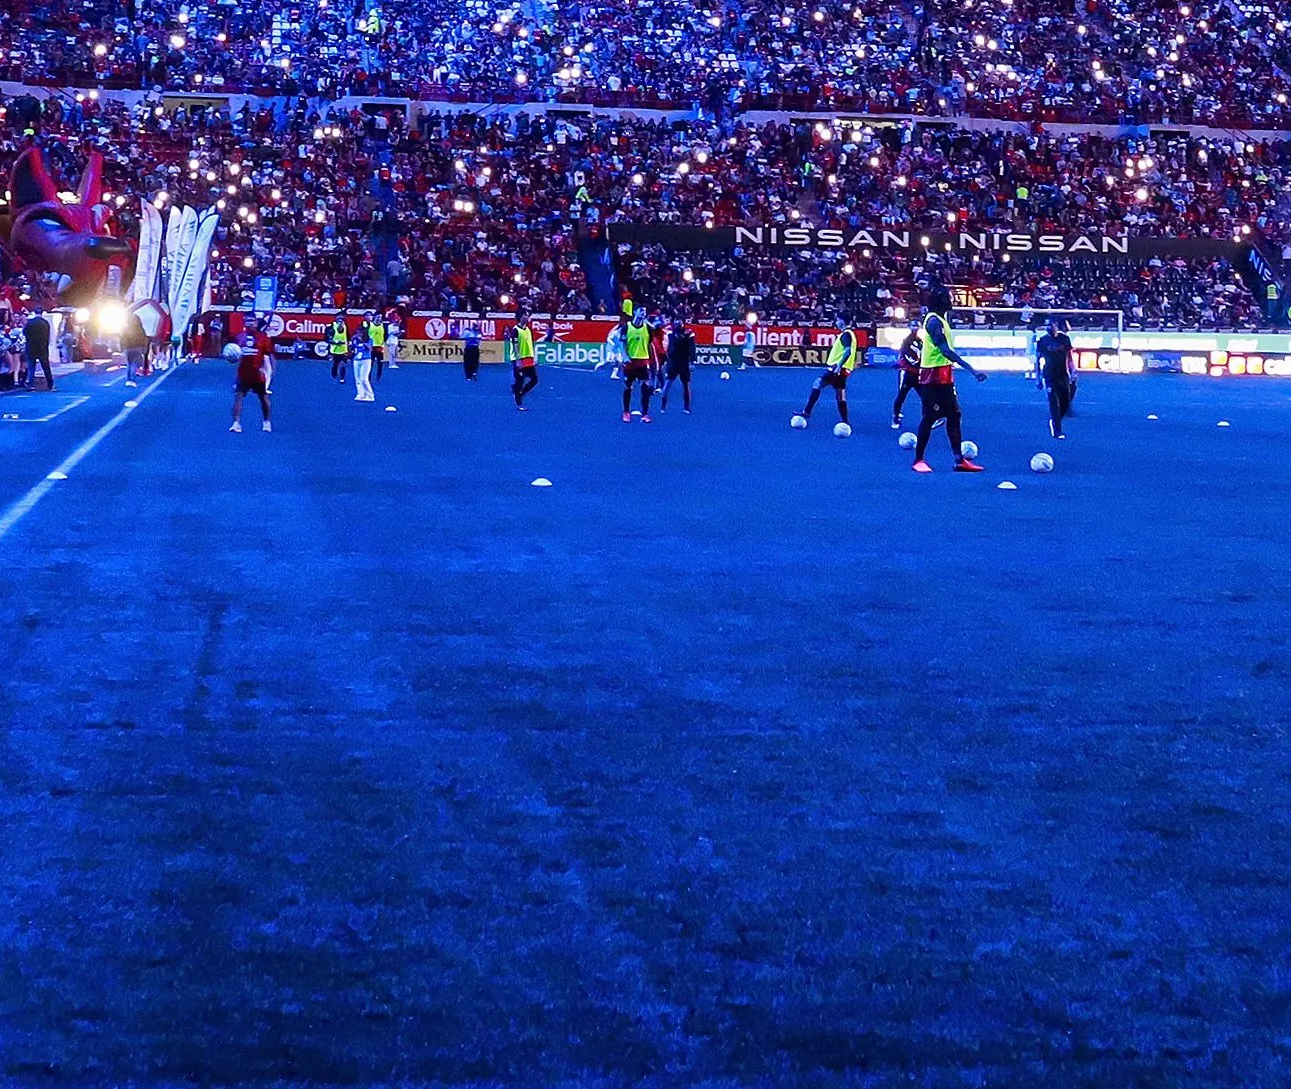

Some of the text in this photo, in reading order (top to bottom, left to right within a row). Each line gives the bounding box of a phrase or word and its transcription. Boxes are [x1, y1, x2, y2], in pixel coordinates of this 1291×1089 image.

[735, 226, 910, 247] NISSAN
[959, 232, 1129, 253] NISSAN
[286, 320, 326, 333] Calim
[532, 321, 573, 330] Rebok
[412, 344, 463, 356] Murph
[535, 345, 606, 363] Falabel
